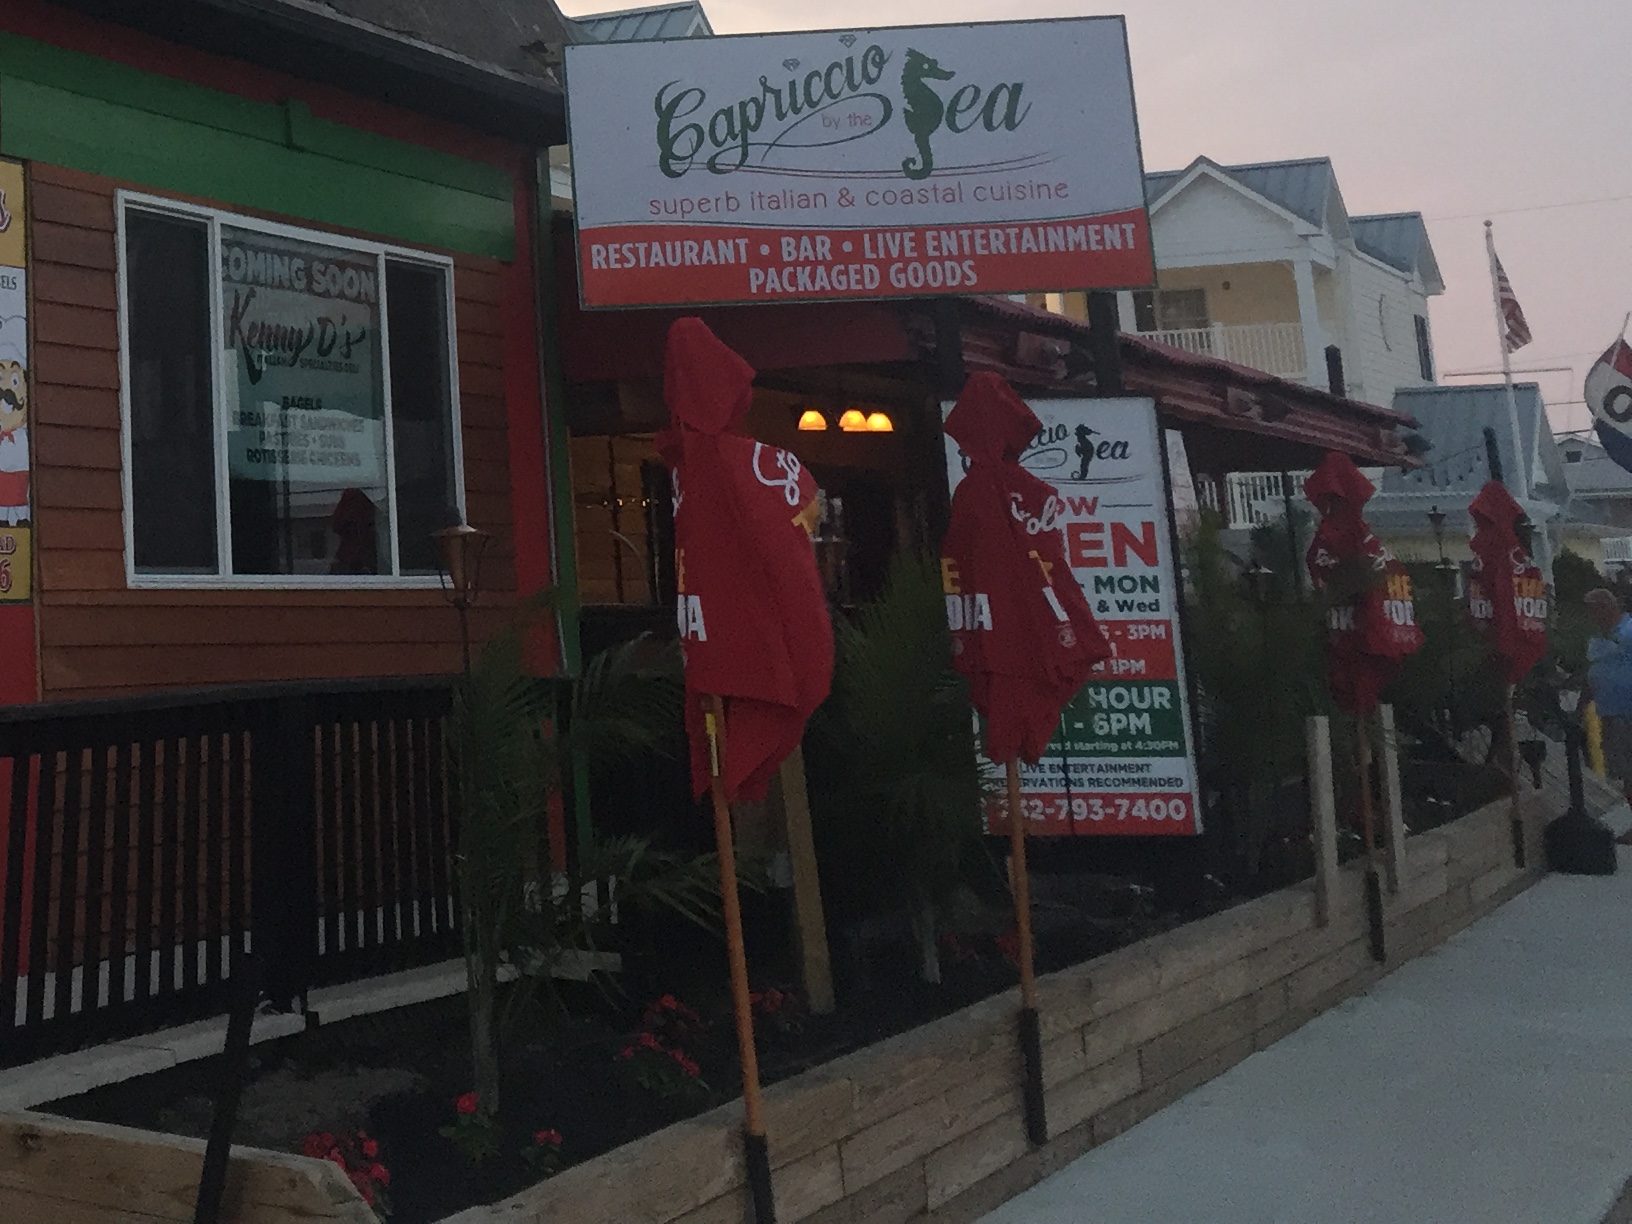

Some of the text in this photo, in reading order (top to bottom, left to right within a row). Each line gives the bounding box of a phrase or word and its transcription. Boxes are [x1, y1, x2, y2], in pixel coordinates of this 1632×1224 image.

[653, 43, 893, 179] Capriccio
[821, 111, 872, 129] by the
[649, 180, 1070, 217] superb italian & coastal cuisine
[591, 223, 1136, 269] RESTAURANT BAR LIVE ENTERTAINMENT
[221, 244, 376, 303] COMING SOON
[748, 259, 978, 293] PACKAGED GOODS
[229, 287, 366, 385] Kenny D's
[281, 396, 323, 410] BAGELS
[1066, 521, 1159, 568] EN
[1094, 574, 1160, 594] MON
[1097, 599, 1161, 612] & Wed
[1127, 624, 1166, 640] 3PM
[1093, 712, 1153, 736] 6PM
[1049, 763, 1152, 774] ENTERTAINMENT
[1088, 778, 1184, 788] RECOMMENDED
